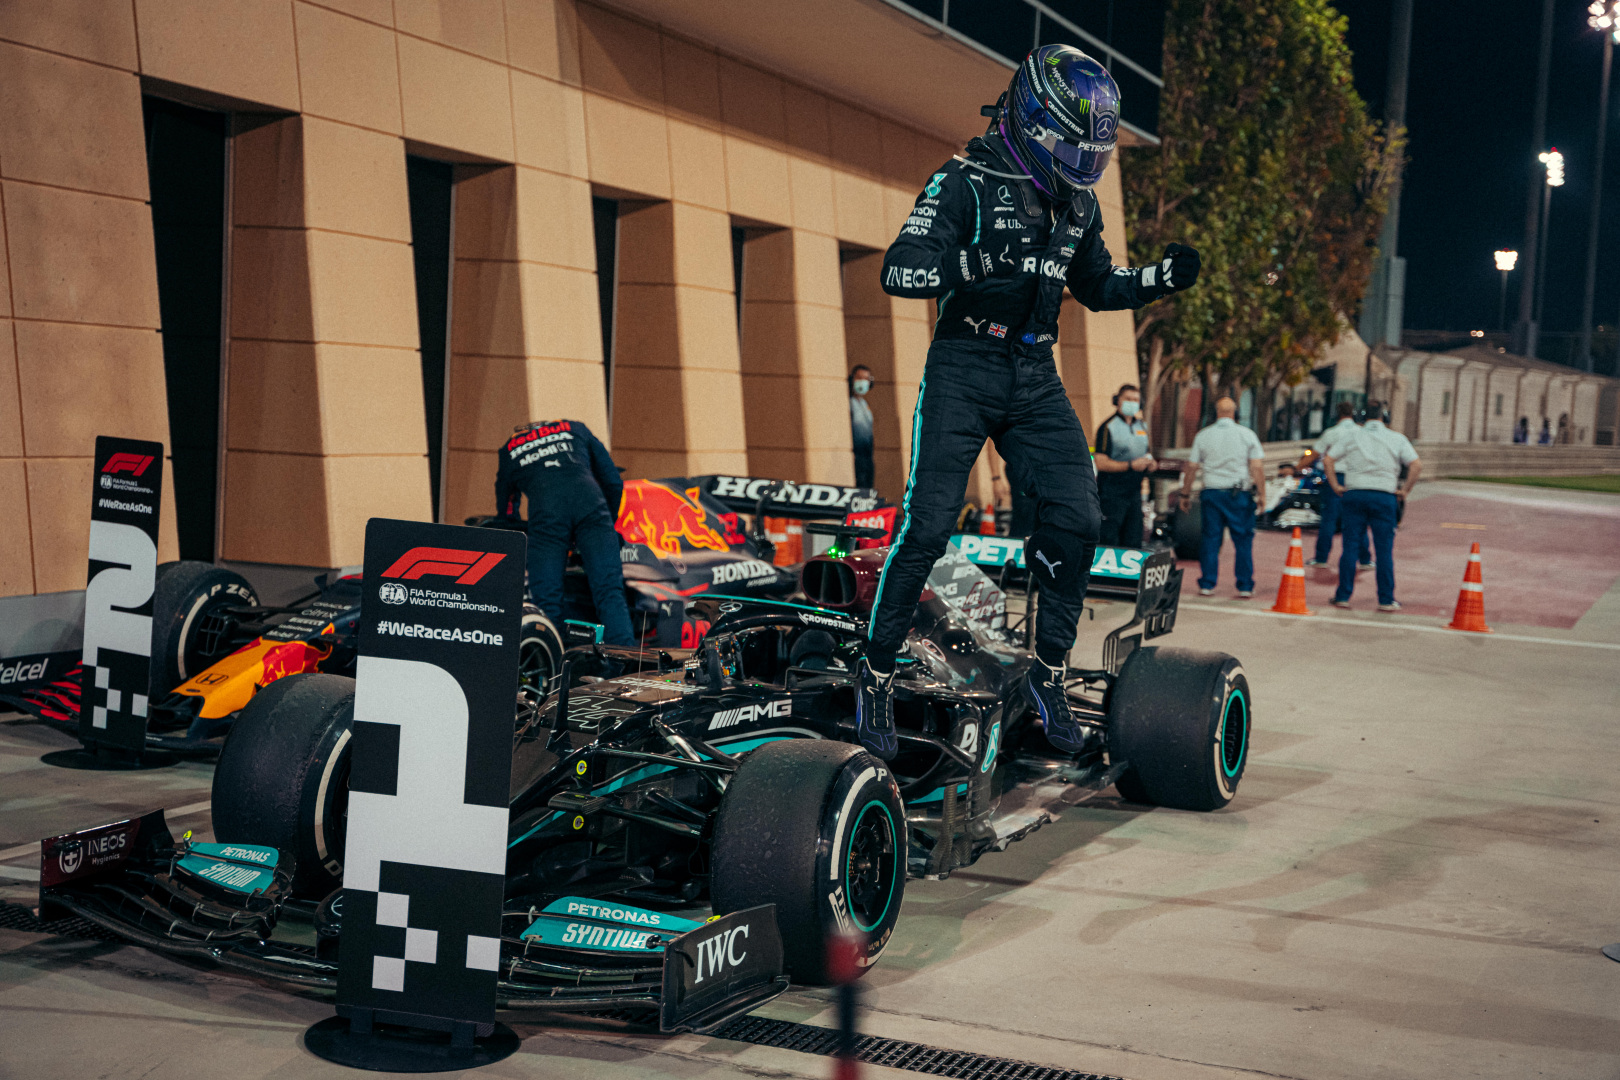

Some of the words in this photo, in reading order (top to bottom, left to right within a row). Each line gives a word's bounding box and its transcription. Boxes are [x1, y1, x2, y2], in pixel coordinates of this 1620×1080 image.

[1028, 55, 1043, 94] CROWDSTRIKE
[1051, 67, 1076, 101] MONSTER
[1047, 100, 1084, 136] CROWDSTRIKE
[1046, 129, 1065, 141] EPSON
[1003, 219, 1027, 229] UB
[886, 266, 941, 288] INEOS
[507, 429, 538, 451] Red
[538, 422, 571, 437] Bull
[510, 432, 574, 459] HONDA
[519, 443, 558, 467] Mobil
[99, 498, 153, 514] #WeRaceAsOne
[380, 546, 508, 586] F1
[960, 534, 1144, 577] PETAS
[711, 559, 777, 586] HONDA
[211, 584, 222, 596] P
[225, 583, 258, 608] ZER
[379, 583, 408, 605] FIA
[409, 597, 436, 607] World
[410, 588, 424, 597] FIA
[425, 590, 461, 600] Formula
[377, 620, 504, 646] #WeRaceAsOne
[802, 613, 856, 632] CROWDSTRIKE
[735, 699, 793, 725] AMG
[87, 832, 126, 856] INEOS
[219, 846, 271, 863] PETRONAS
[91, 853, 121, 866] Hygienics
[198, 862, 262, 888] SYNTIUM
[566, 902, 661, 926] PETRONAS
[694, 924, 750, 985] IWC
